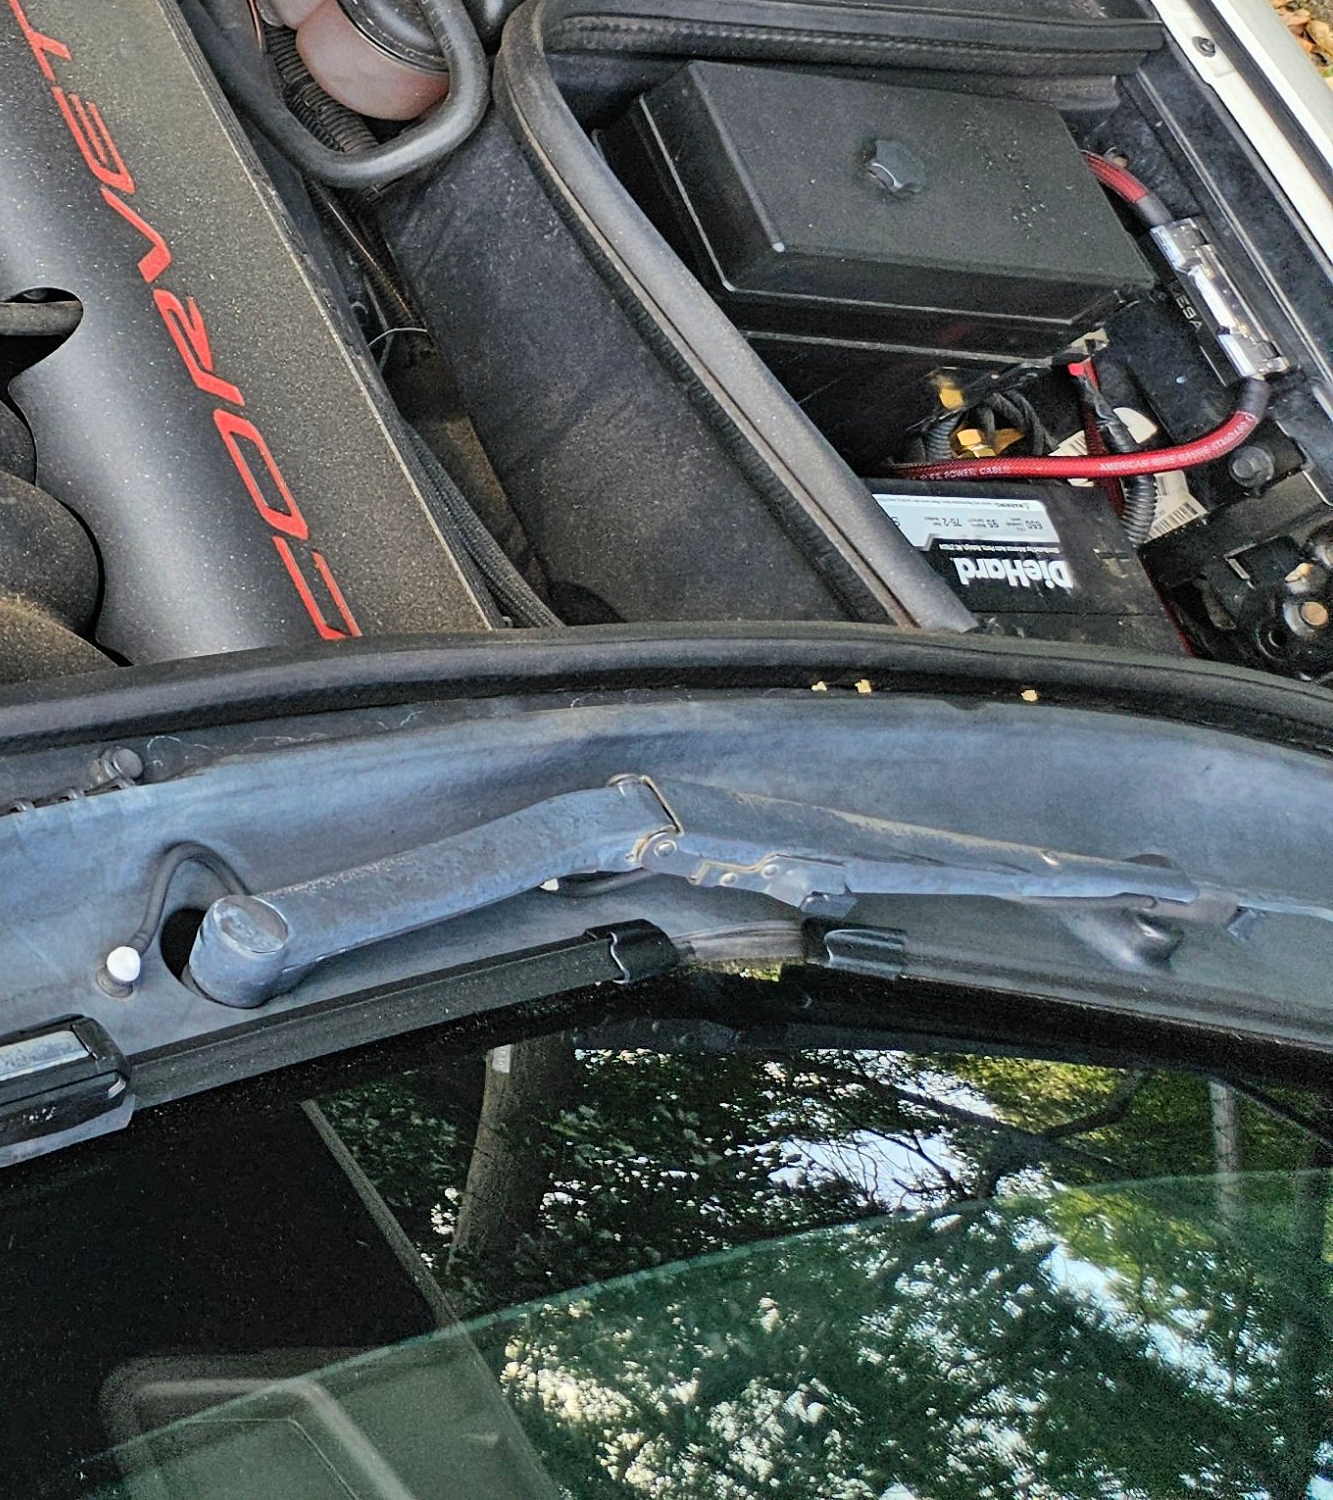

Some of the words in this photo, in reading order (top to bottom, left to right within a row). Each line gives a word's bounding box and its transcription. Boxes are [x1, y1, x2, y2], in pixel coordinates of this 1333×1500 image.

[985, 518, 999, 528] 95
[1023, 519, 1042, 530] 650
[953, 557, 1073, 587] DieHard
